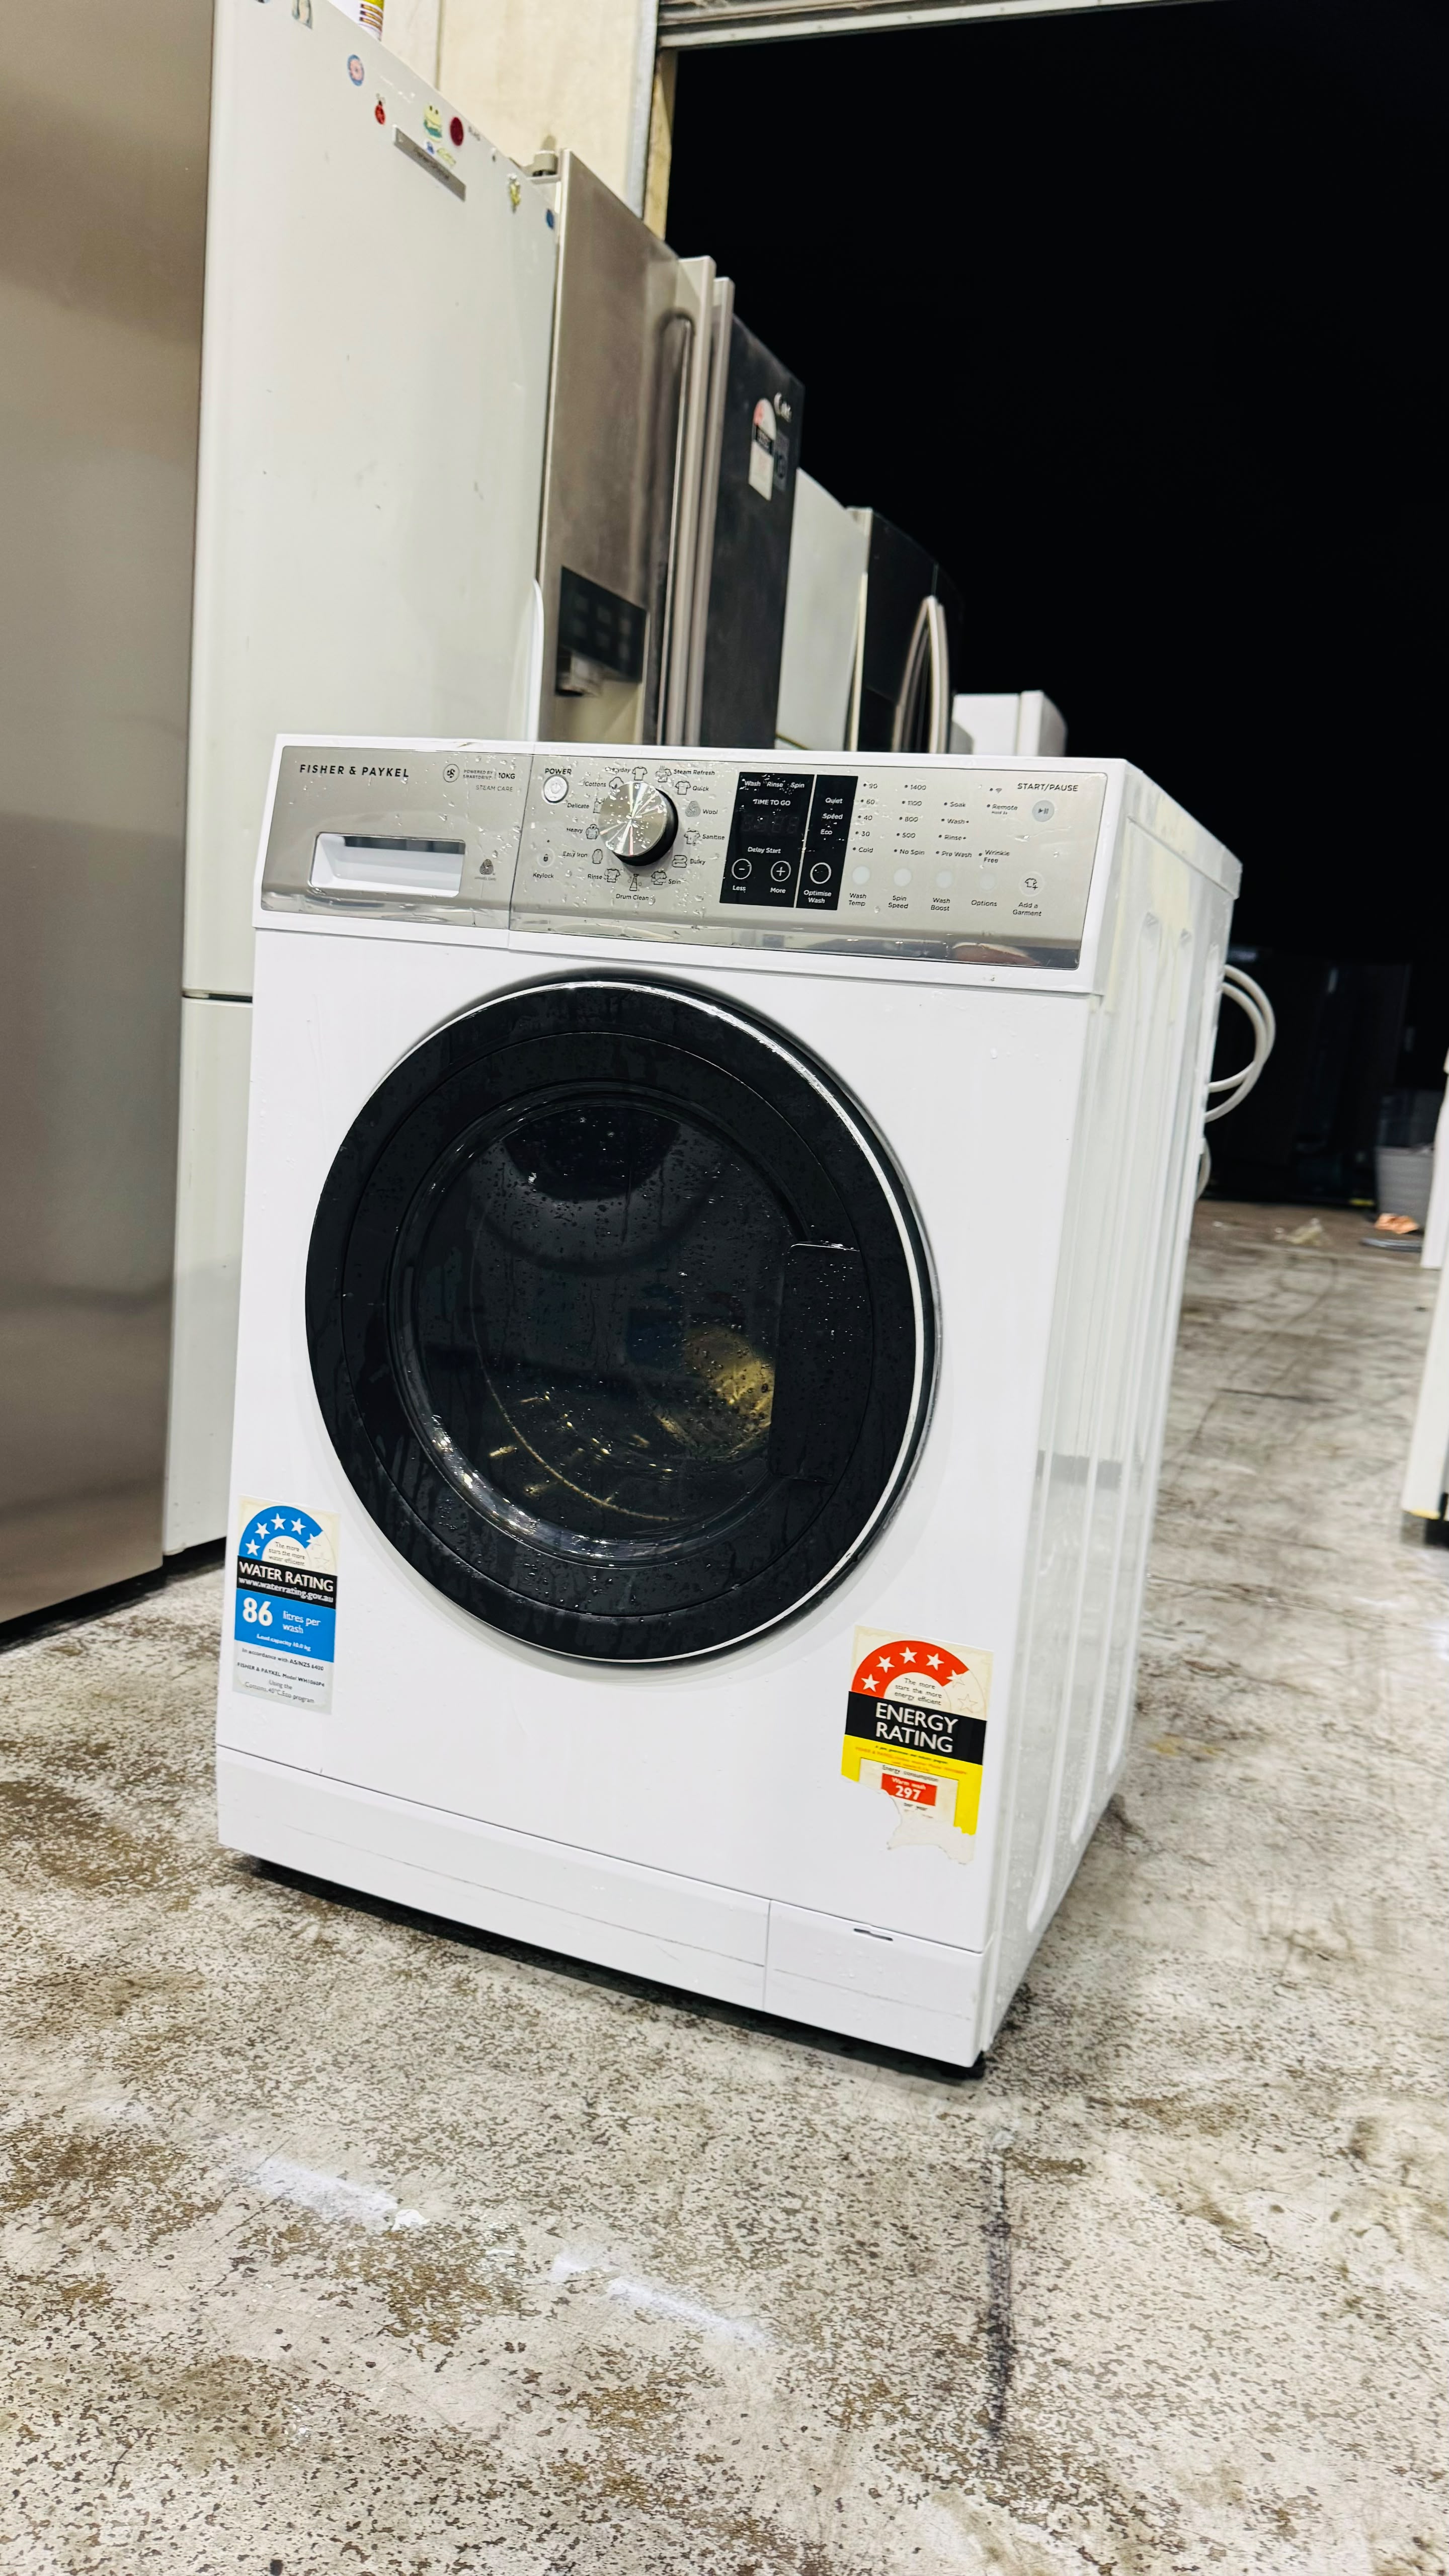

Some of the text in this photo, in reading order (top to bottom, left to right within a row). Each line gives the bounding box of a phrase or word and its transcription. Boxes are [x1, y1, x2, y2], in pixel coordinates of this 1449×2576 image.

[299, 764, 410, 778] FISHER & PAYKEL
[1017, 783, 1079, 791] START/PAUSE
[239, 1561, 334, 1592] WATER RATING
[238, 1577, 333, 1602] www.waterrating.gov.au
[243, 1597, 273, 1626] 86
[283, 1611, 321, 1627] litres per
[282, 1624, 304, 1634] wash
[271, 1638, 292, 1647] capacity
[249, 1650, 276, 1660] accordance
[237, 1662, 255, 1670] FISHER
[262, 1668, 281, 1677] PAYKEL
[904, 1677, 916, 1685] The
[293, 1692, 314, 1704] program
[894, 1692, 942, 1706] energy efficient
[875, 1702, 958, 1733] ENERGY
[875, 1722, 953, 1753] RATING
[882, 1765, 900, 1774] Energy
[904, 1771, 939, 1782] consumption
[892, 1777, 926, 1790] Warm wash
[895, 1785, 922, 1800] 297
